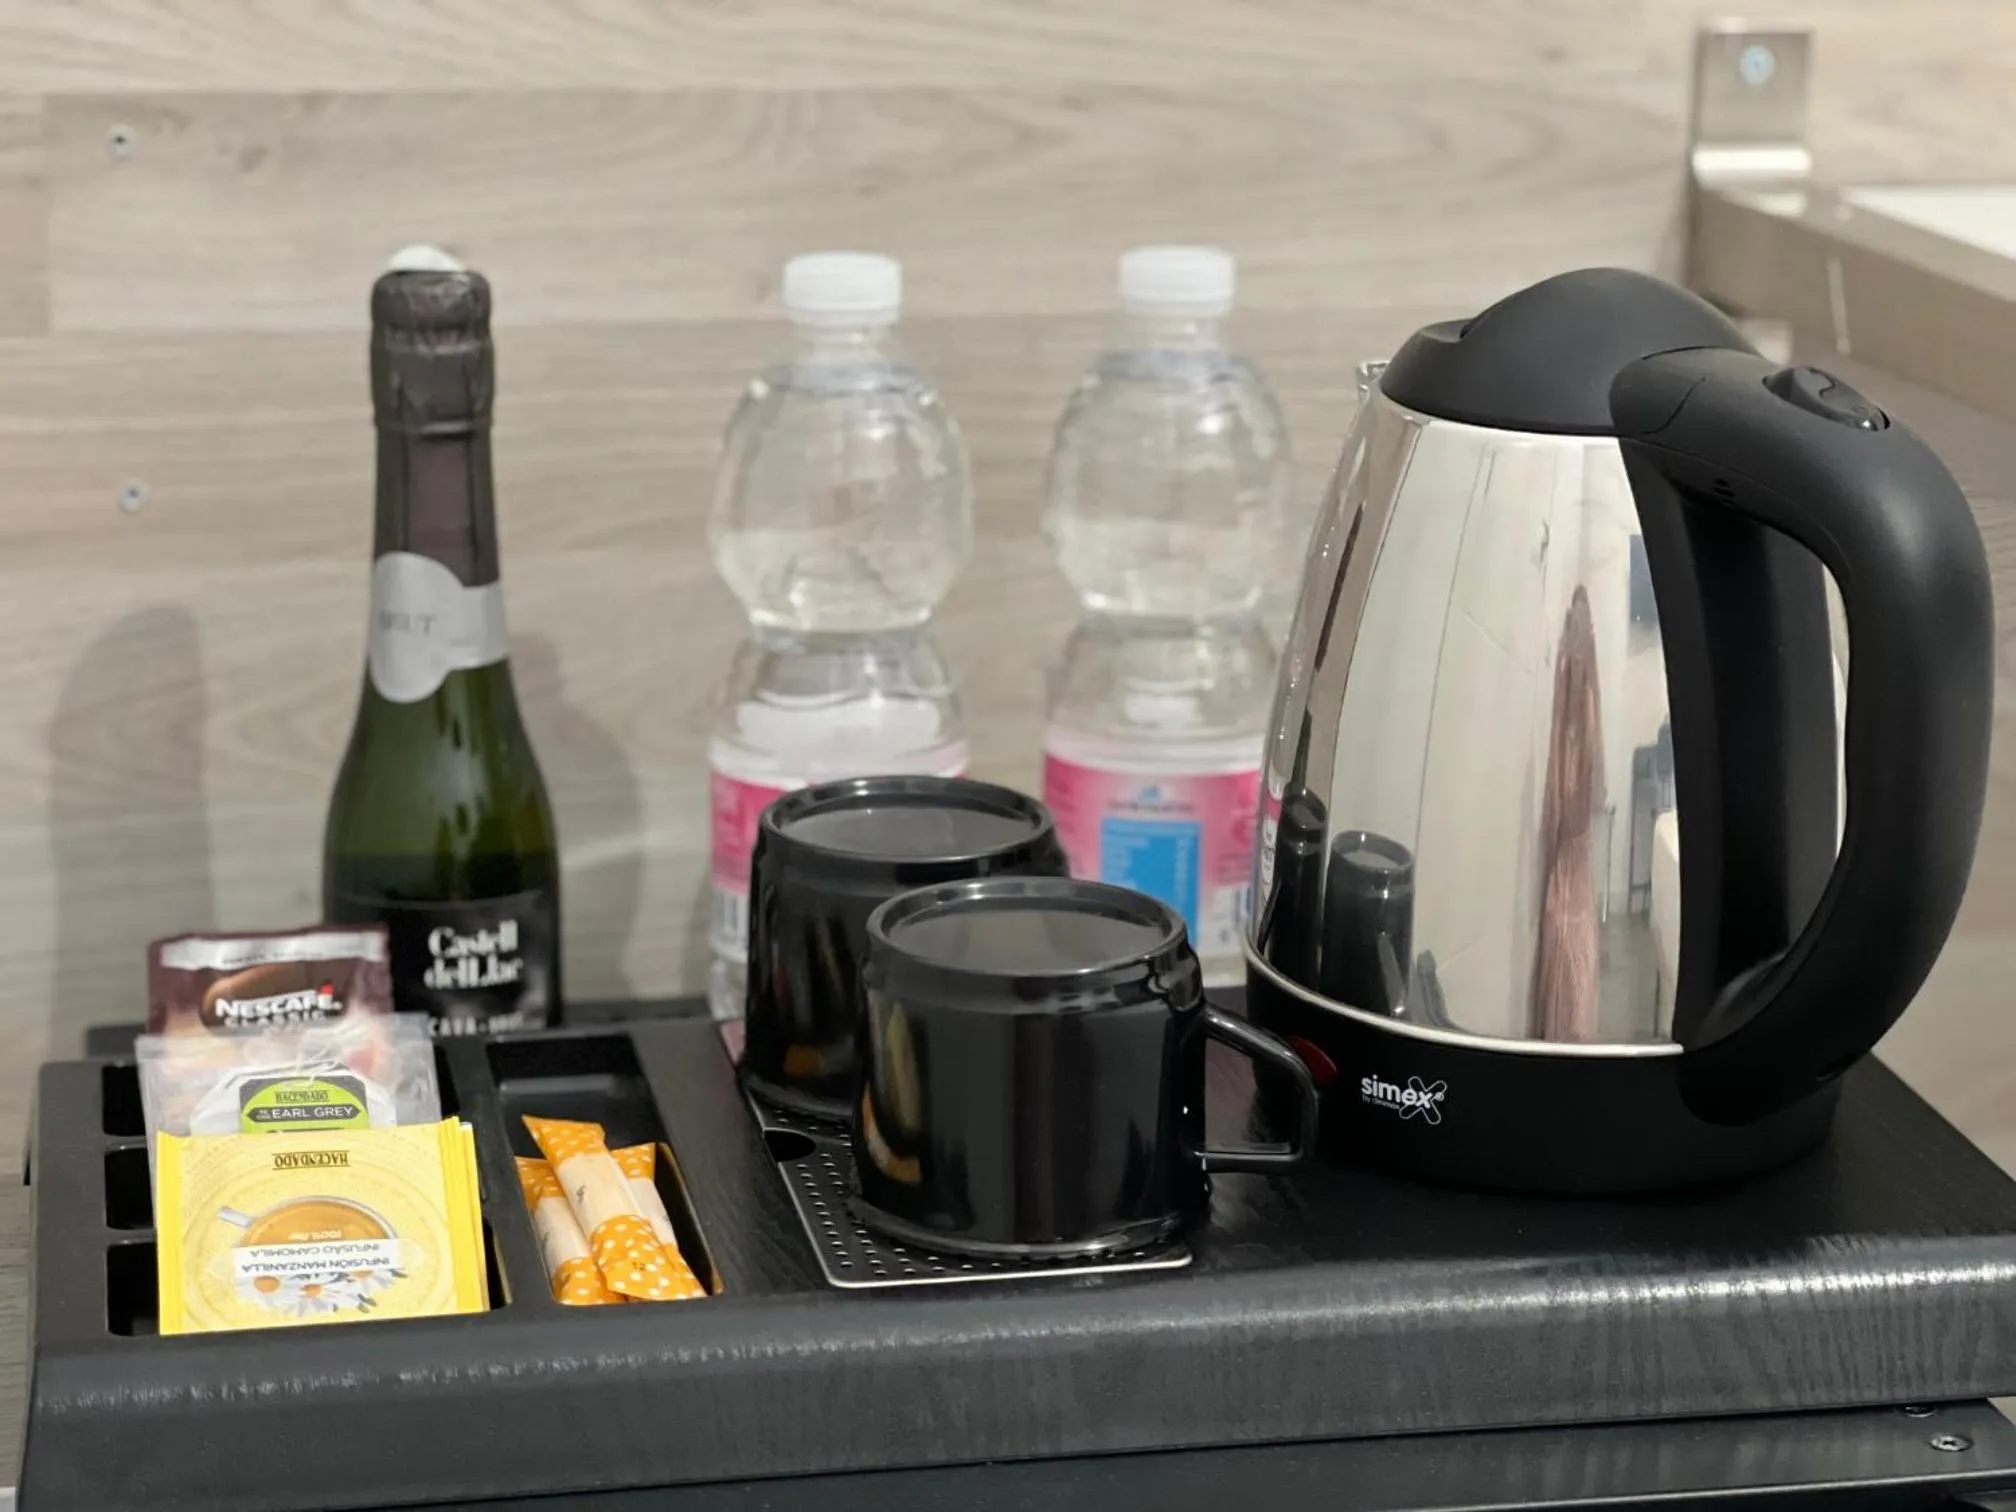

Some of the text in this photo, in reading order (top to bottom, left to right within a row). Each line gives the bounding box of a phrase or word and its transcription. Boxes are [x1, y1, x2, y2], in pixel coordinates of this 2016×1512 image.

[428, 918, 518, 957] Castell
[215, 981, 335, 1017] NESCAFÉ
[1361, 1074, 1432, 1109] simex
[272, 1107, 311, 1119] EARL
[314, 1105, 353, 1117] GREY
[273, 1151, 350, 1168] HACENDADO
